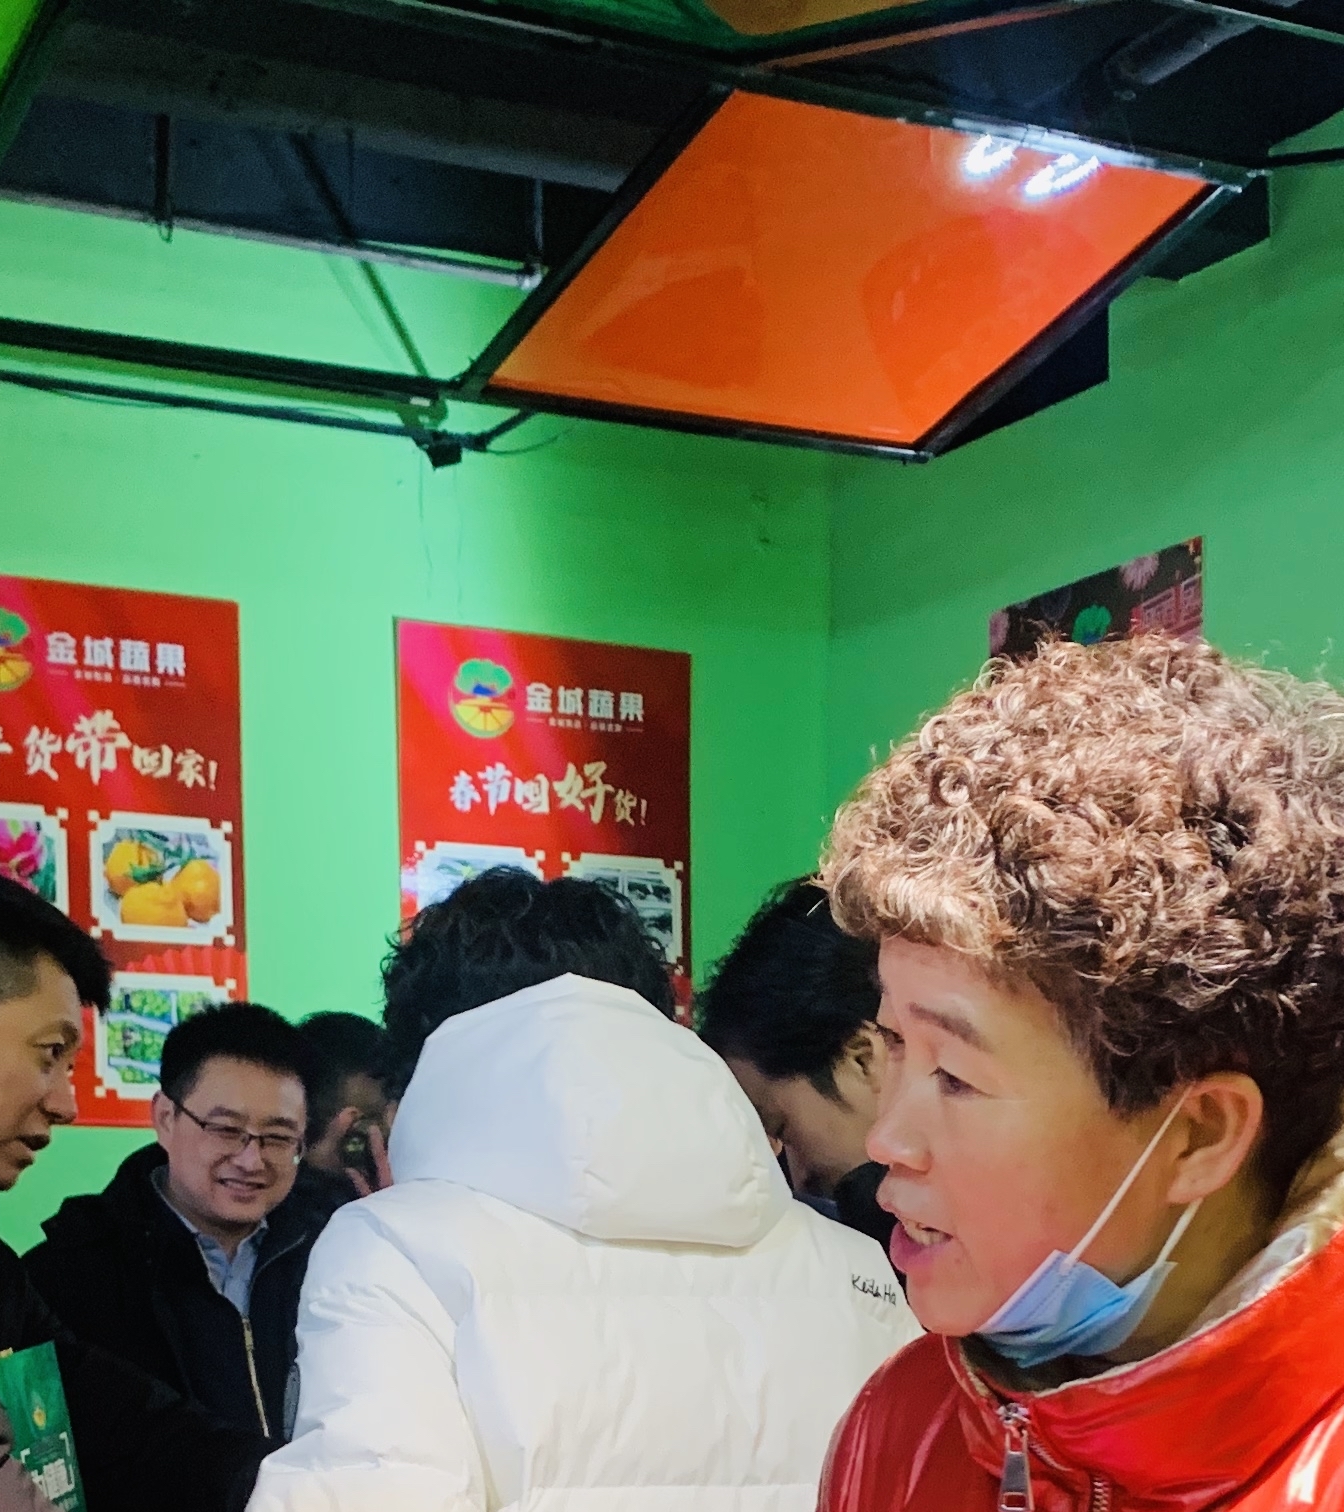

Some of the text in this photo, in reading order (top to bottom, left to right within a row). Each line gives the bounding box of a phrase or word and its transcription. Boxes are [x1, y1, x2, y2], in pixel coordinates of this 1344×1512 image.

[46, 631, 186, 677] 金城蔬果
[525, 682, 644, 722] 金城蔬果
